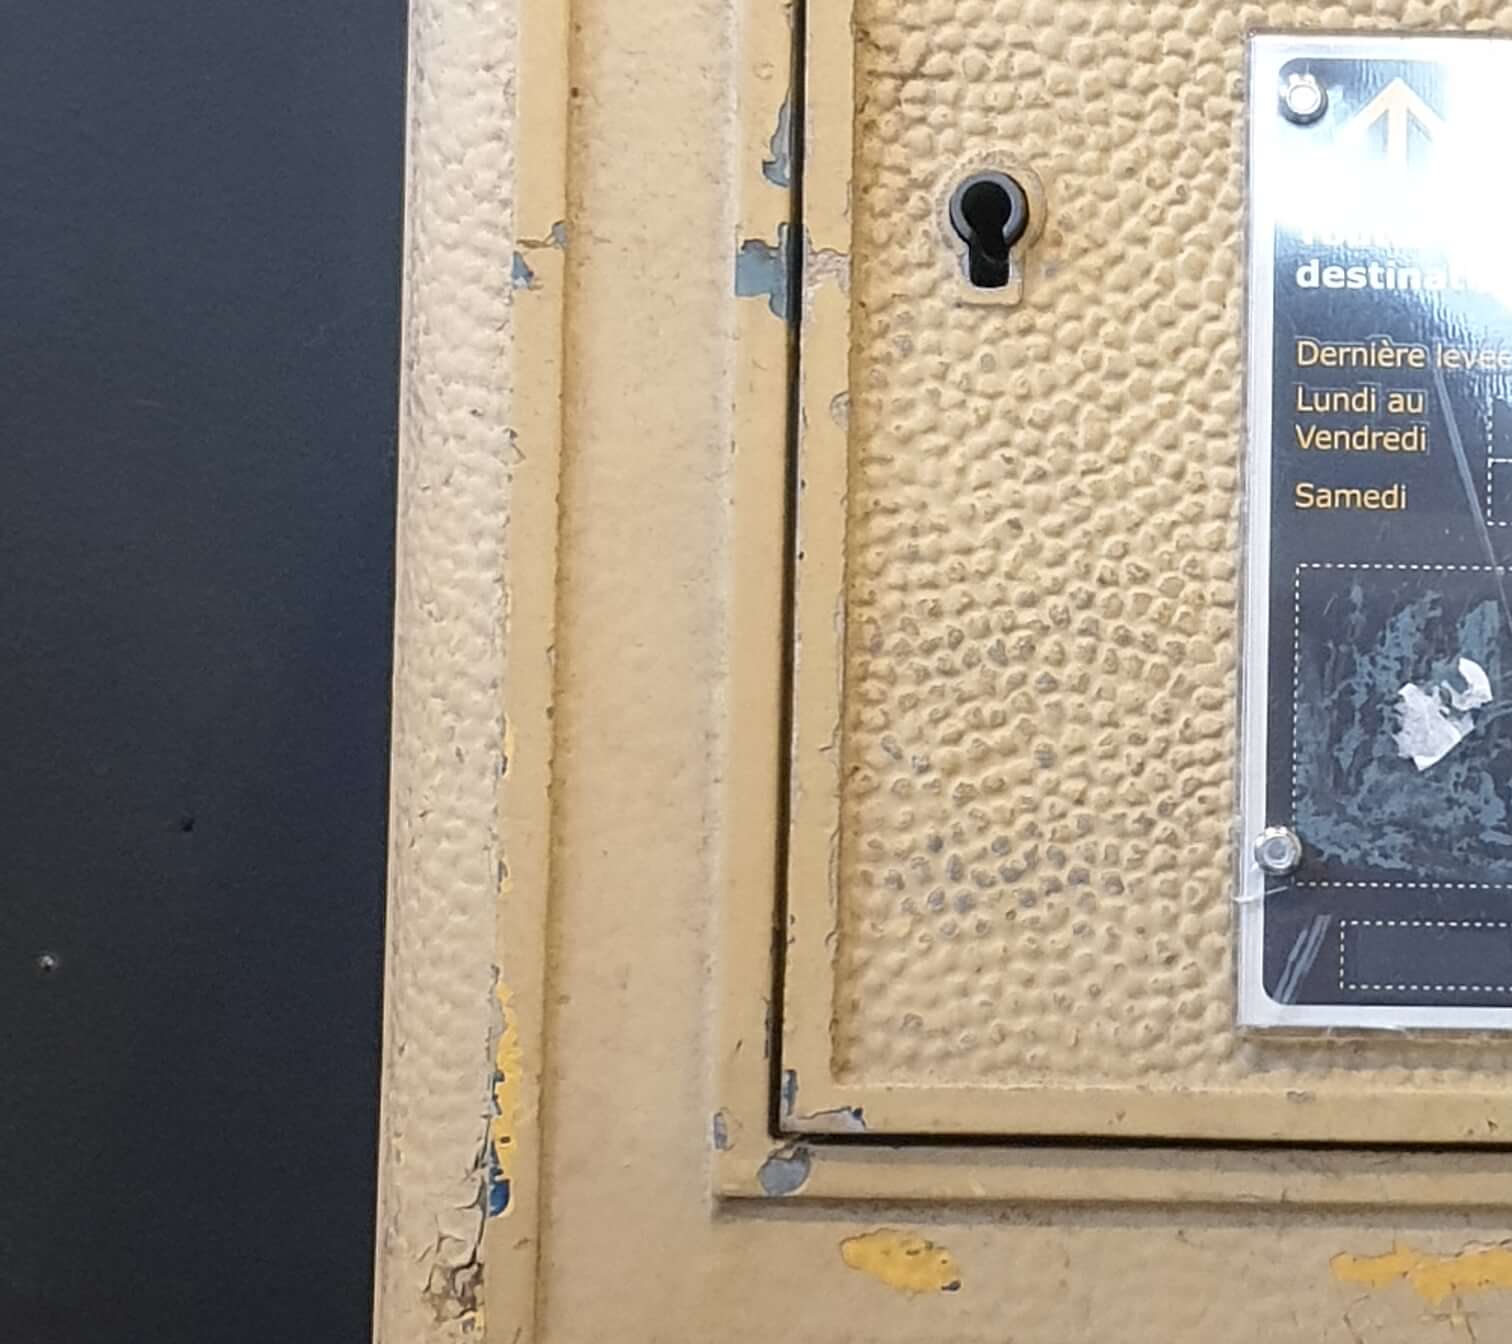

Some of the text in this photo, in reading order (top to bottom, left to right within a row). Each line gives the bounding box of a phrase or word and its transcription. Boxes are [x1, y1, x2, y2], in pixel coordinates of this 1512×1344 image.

[1297, 339, 1425, 368] Dernière
[1296, 386, 1423, 414] Lundi au
[1295, 424, 1426, 452] Vendredi
[1295, 482, 1407, 510] Samedi
